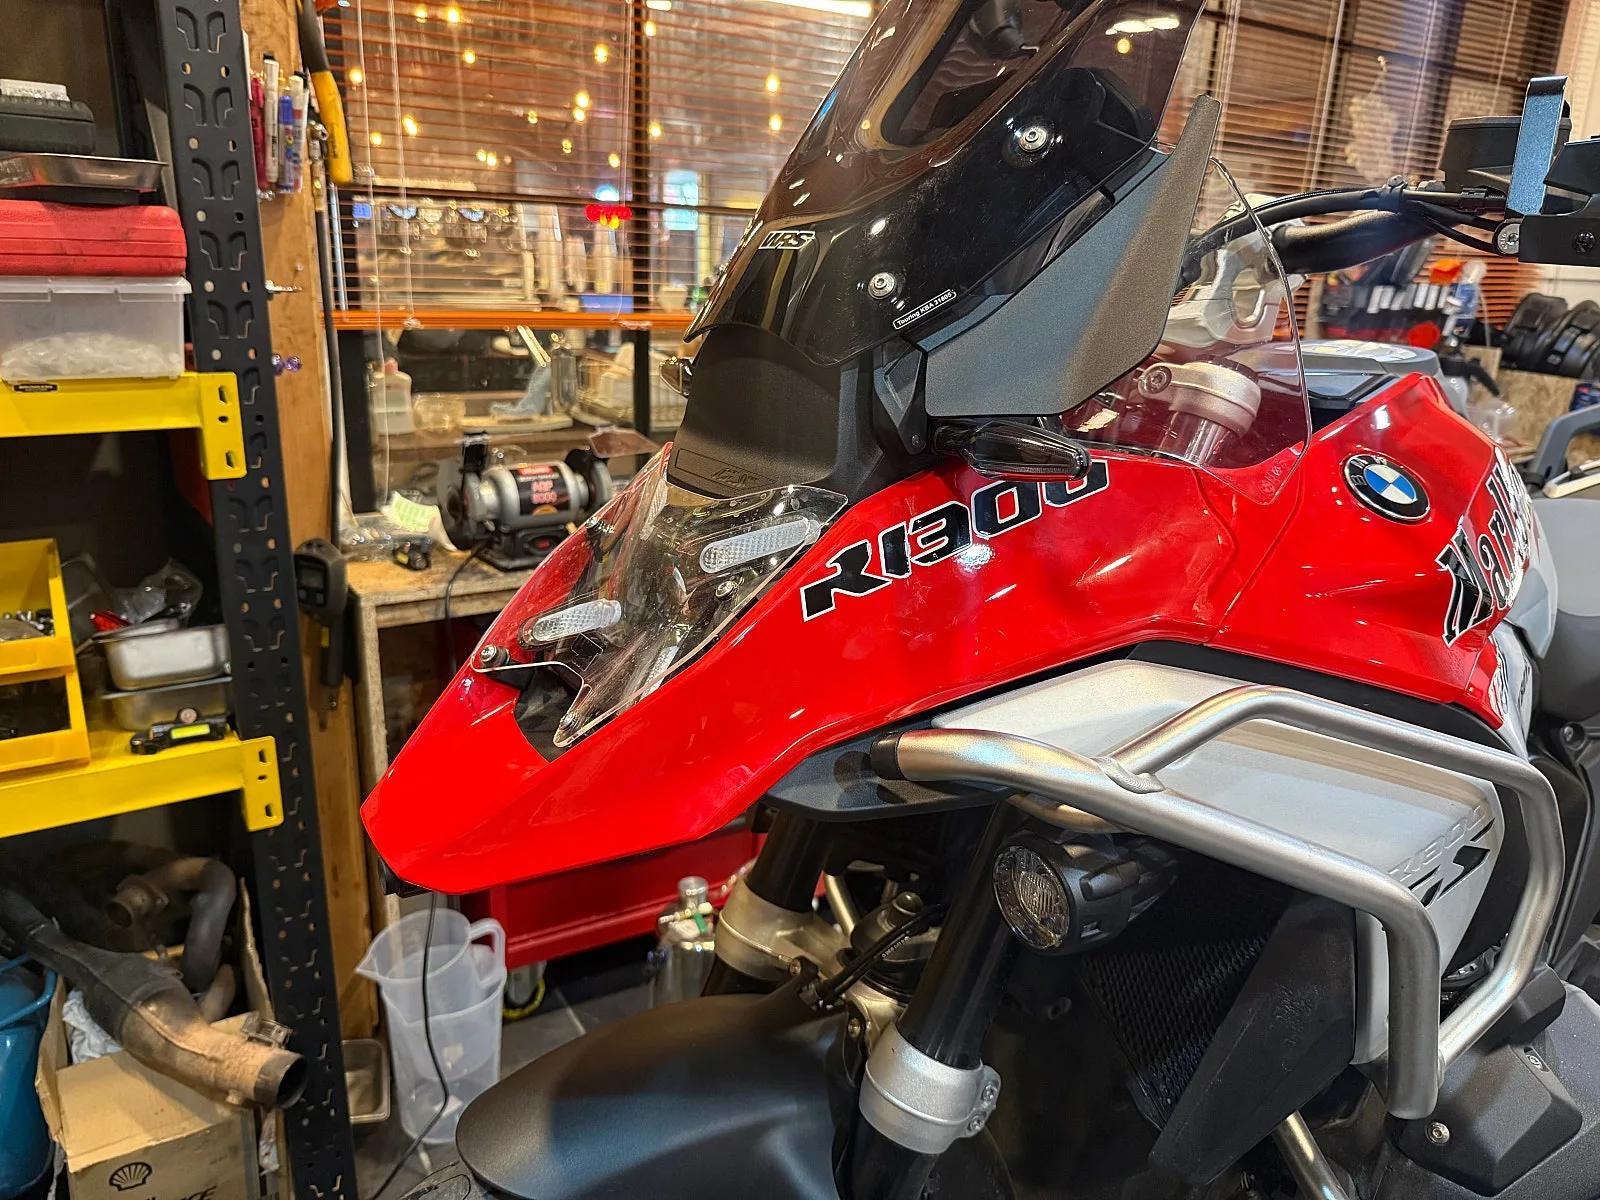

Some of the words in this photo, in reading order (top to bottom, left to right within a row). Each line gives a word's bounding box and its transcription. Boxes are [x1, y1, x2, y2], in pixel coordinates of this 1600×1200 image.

[896, 310, 920, 326] Touring
[919, 302, 935, 314] KBA
[1348, 455, 1388, 486] BMW
[800, 459, 1110, 622] R1300
